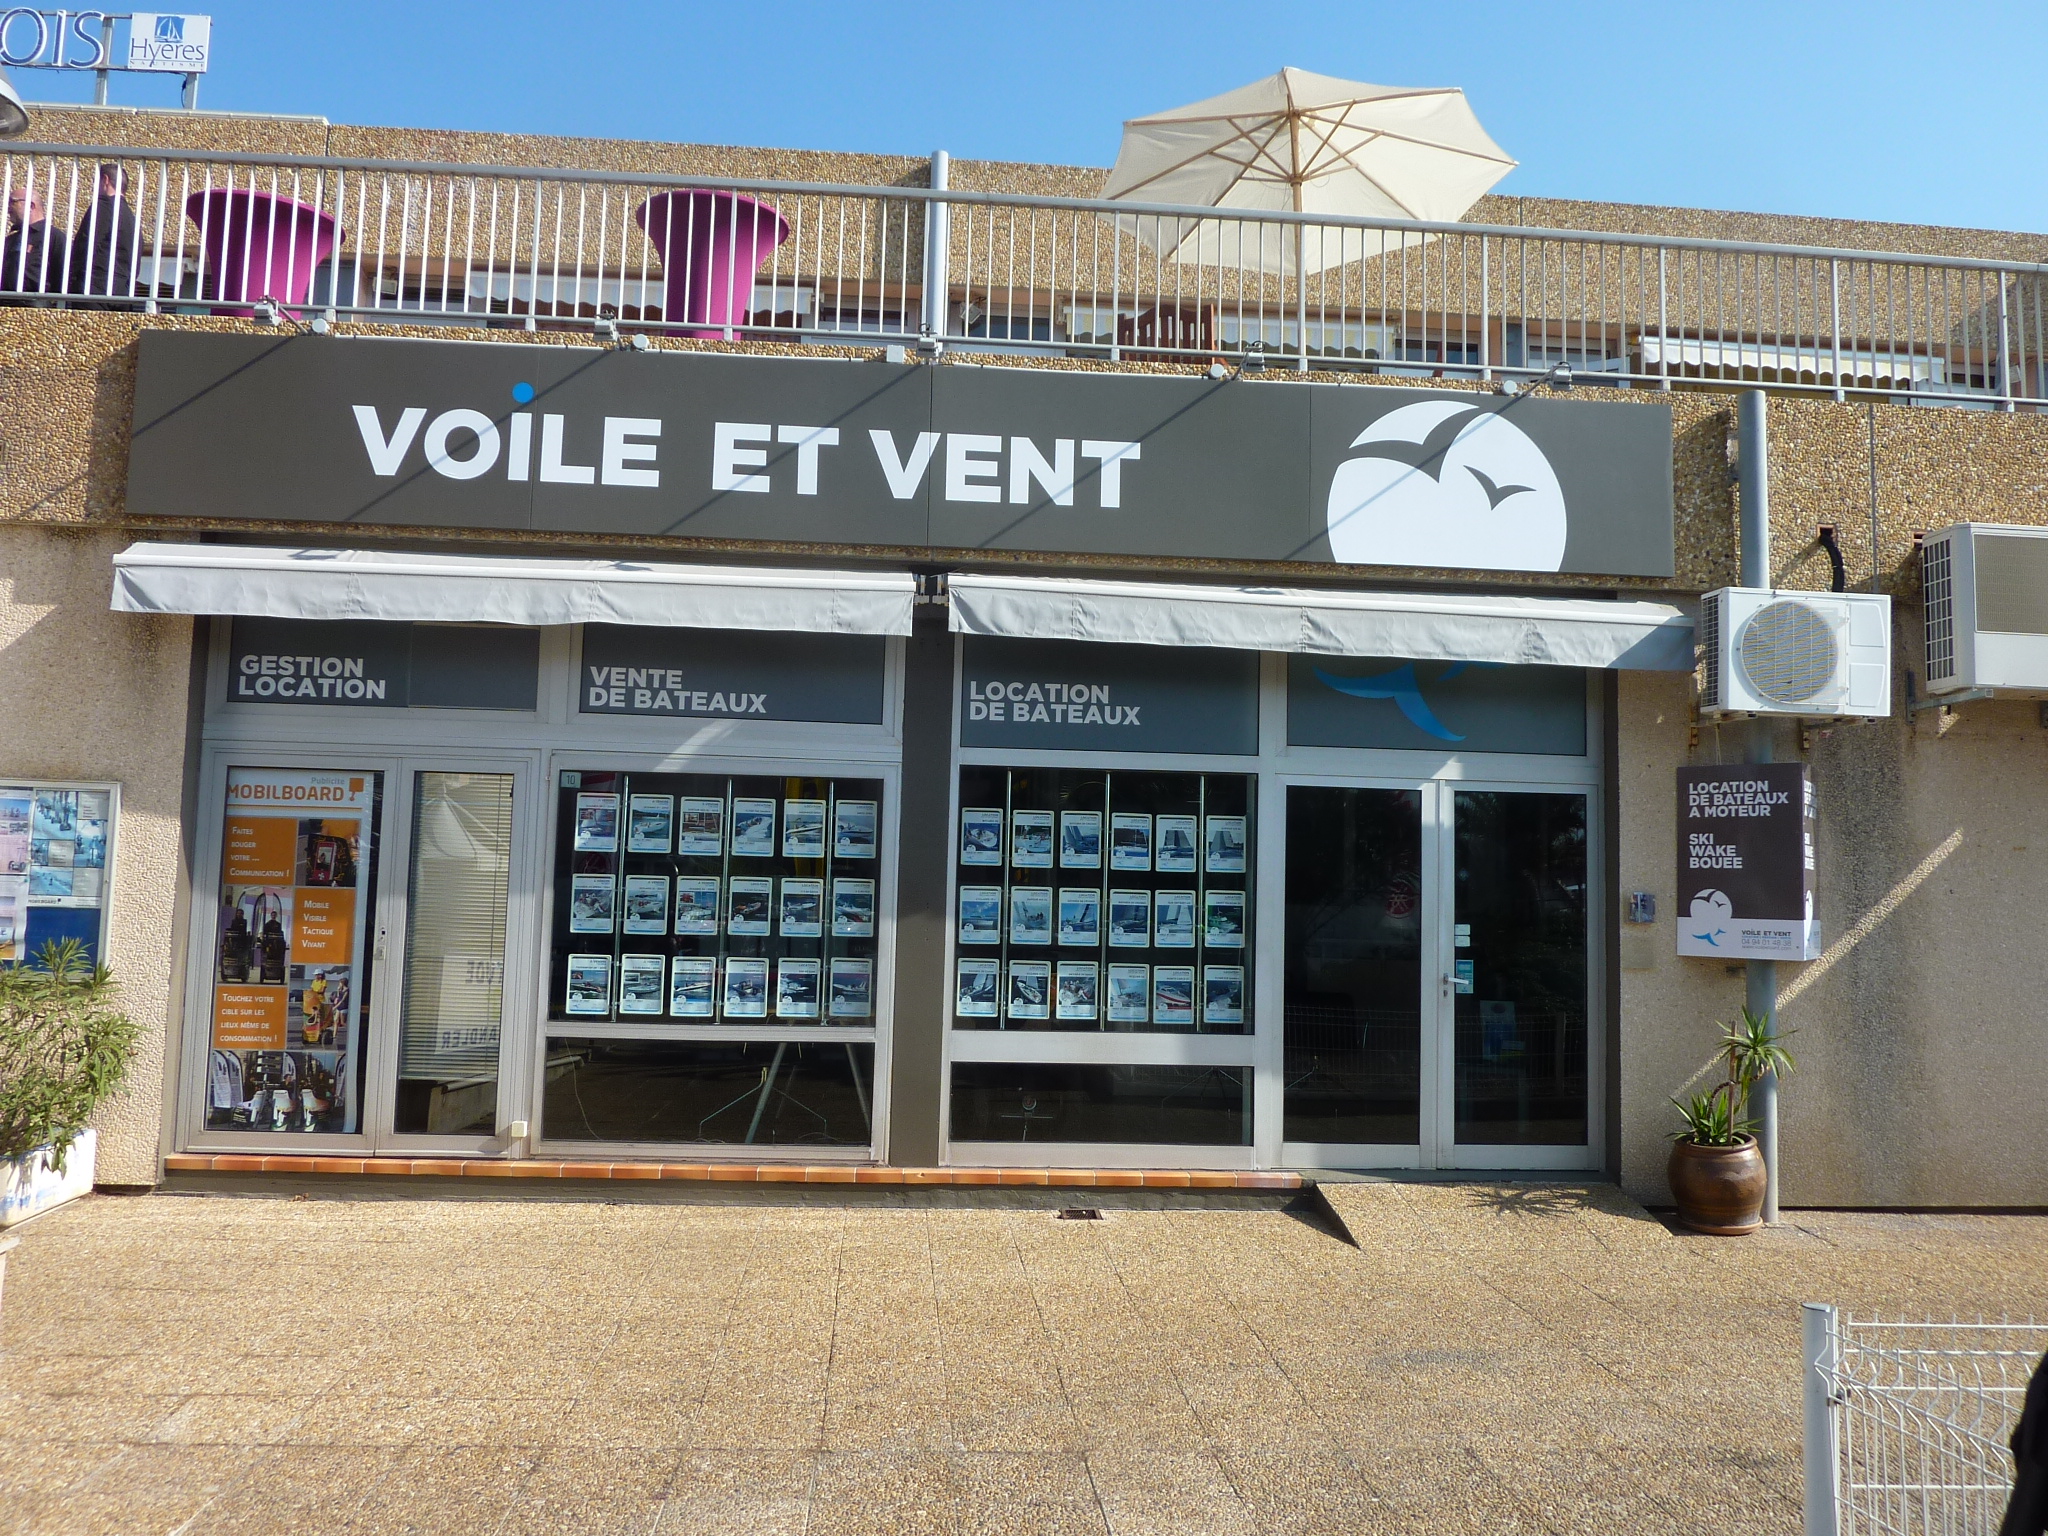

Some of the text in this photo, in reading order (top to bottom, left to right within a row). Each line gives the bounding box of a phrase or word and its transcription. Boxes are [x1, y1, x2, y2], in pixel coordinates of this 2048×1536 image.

[130, 37, 204, 67] Hyeres
[351, 381, 1142, 508] VOILE ET VENT
[239, 655, 364, 678] GESTION
[238, 676, 387, 700] LOCATION
[590, 666, 683, 689] VENTE
[589, 686, 768, 714] DE BATEAUX
[969, 680, 1110, 705] LOCATION
[969, 701, 1141, 727] DE BATEAUX
[566, 774, 576, 785] 10
[1689, 780, 1769, 794] LOCATION
[227, 783, 345, 802] MOBILBOARD
[1689, 792, 1789, 806] DE BATEAUX
[1689, 805, 1771, 818] A MOTEUR
[1689, 833, 1714, 846] SKI
[1689, 845, 1737, 857] WAKE
[1689, 857, 1743, 869] BOUEE
